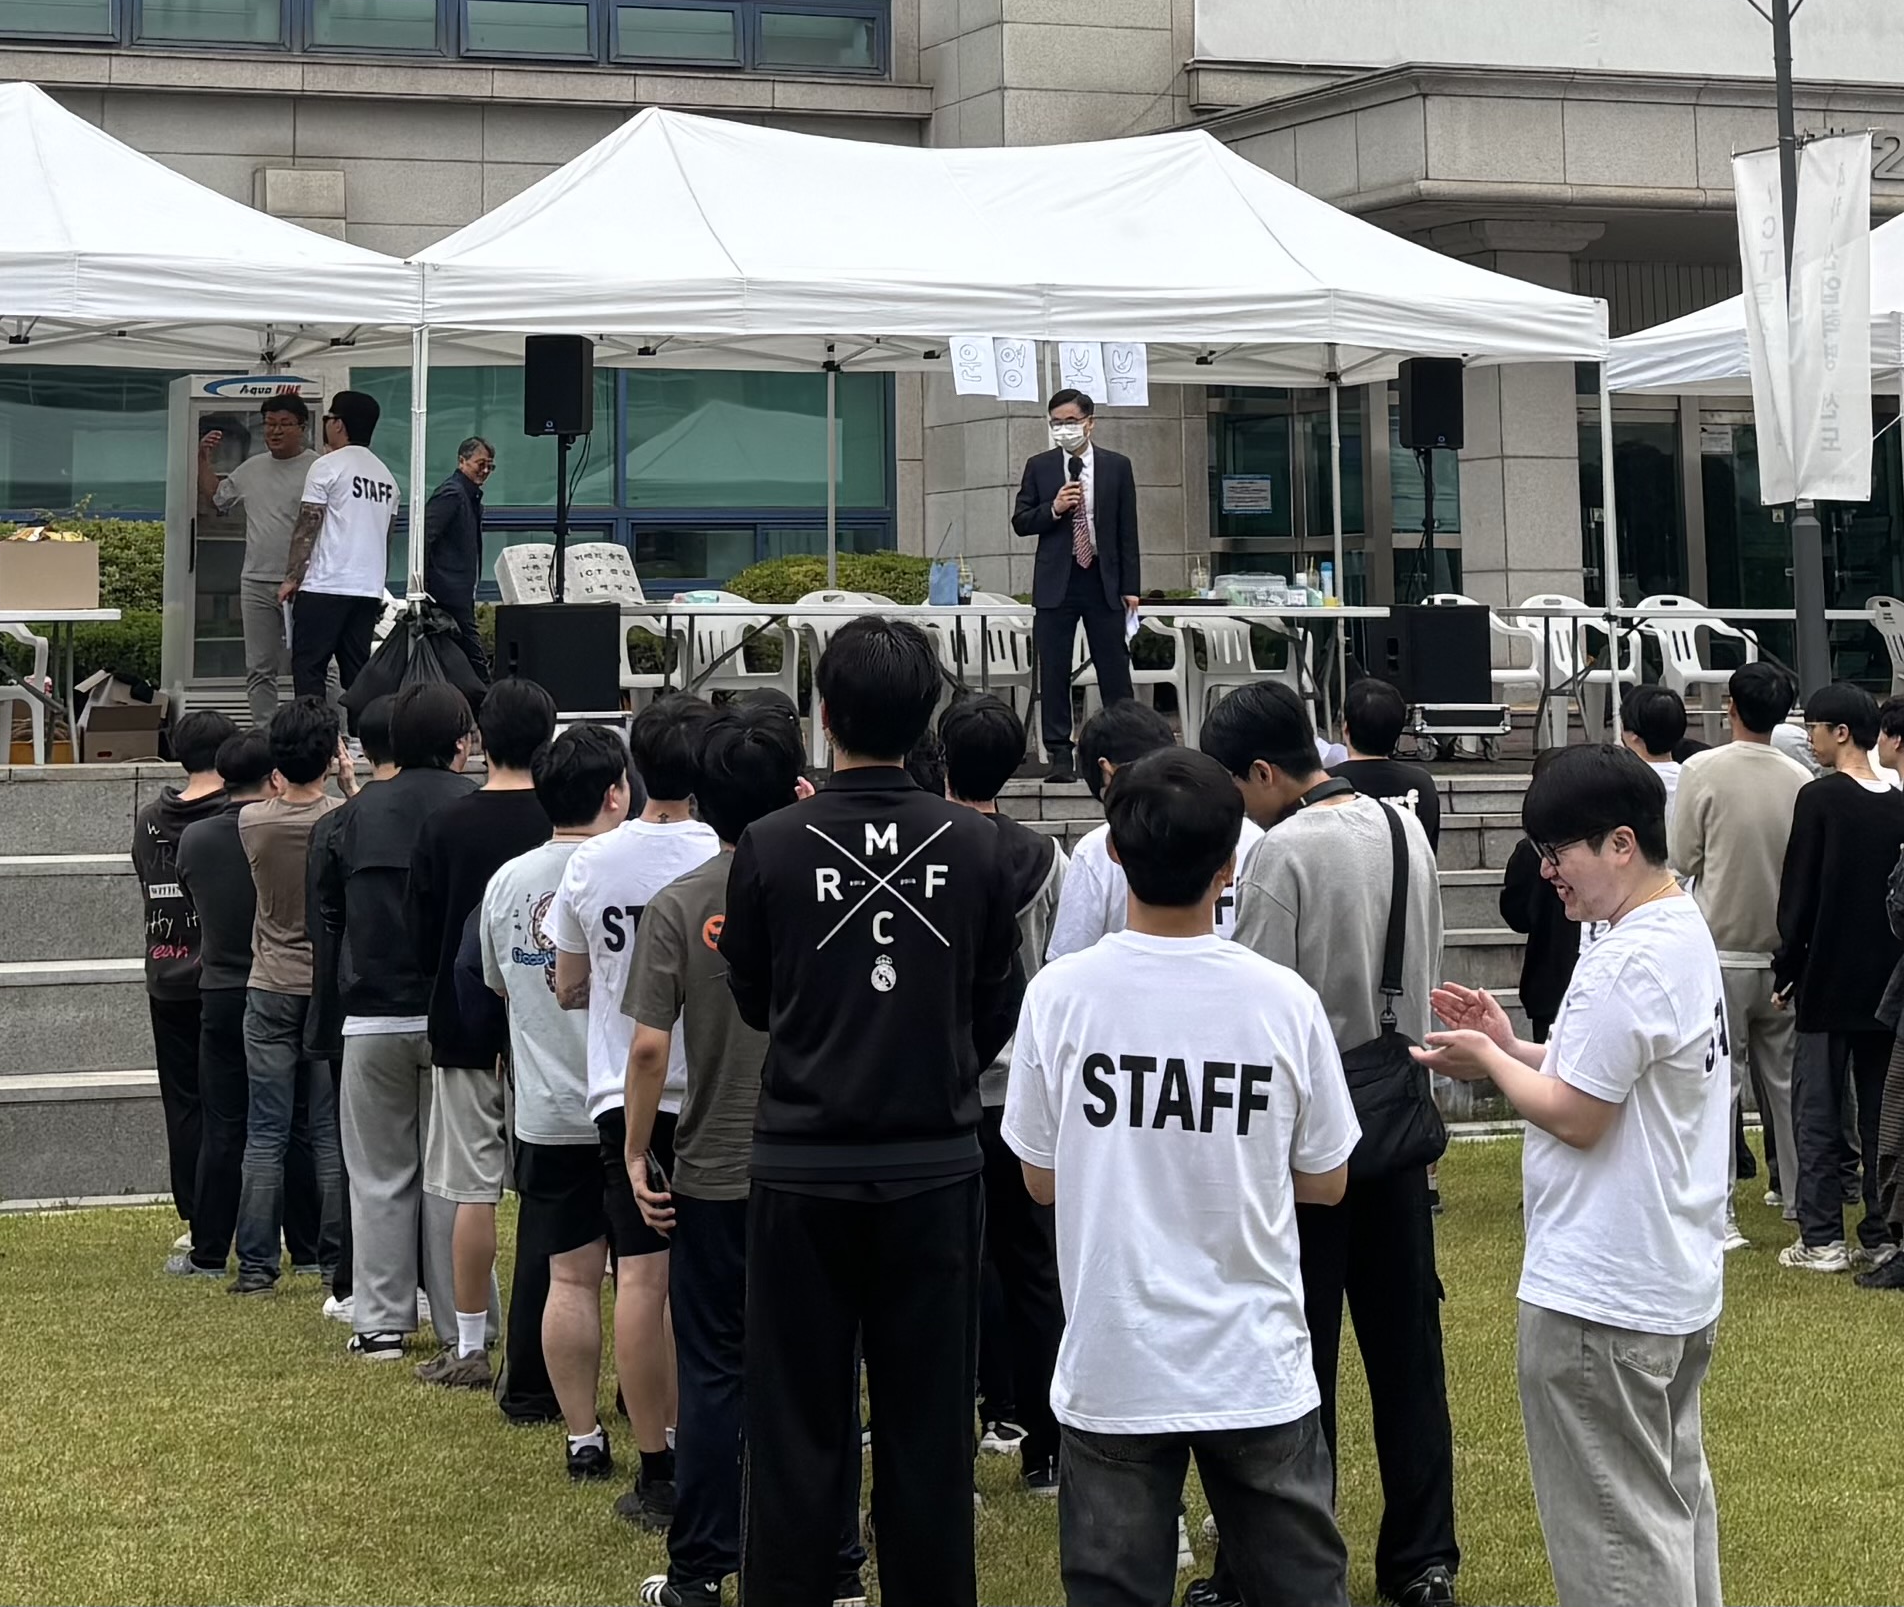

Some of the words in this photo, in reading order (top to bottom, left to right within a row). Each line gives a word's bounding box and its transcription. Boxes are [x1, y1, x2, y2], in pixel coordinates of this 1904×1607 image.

[352, 475, 393, 505] STAFF
[865, 822, 898, 855] M
[815, 867, 843, 902] R
[925, 864, 948, 899] F
[872, 910, 894, 945] C
[1082, 1052, 1273, 1136] STAFF
